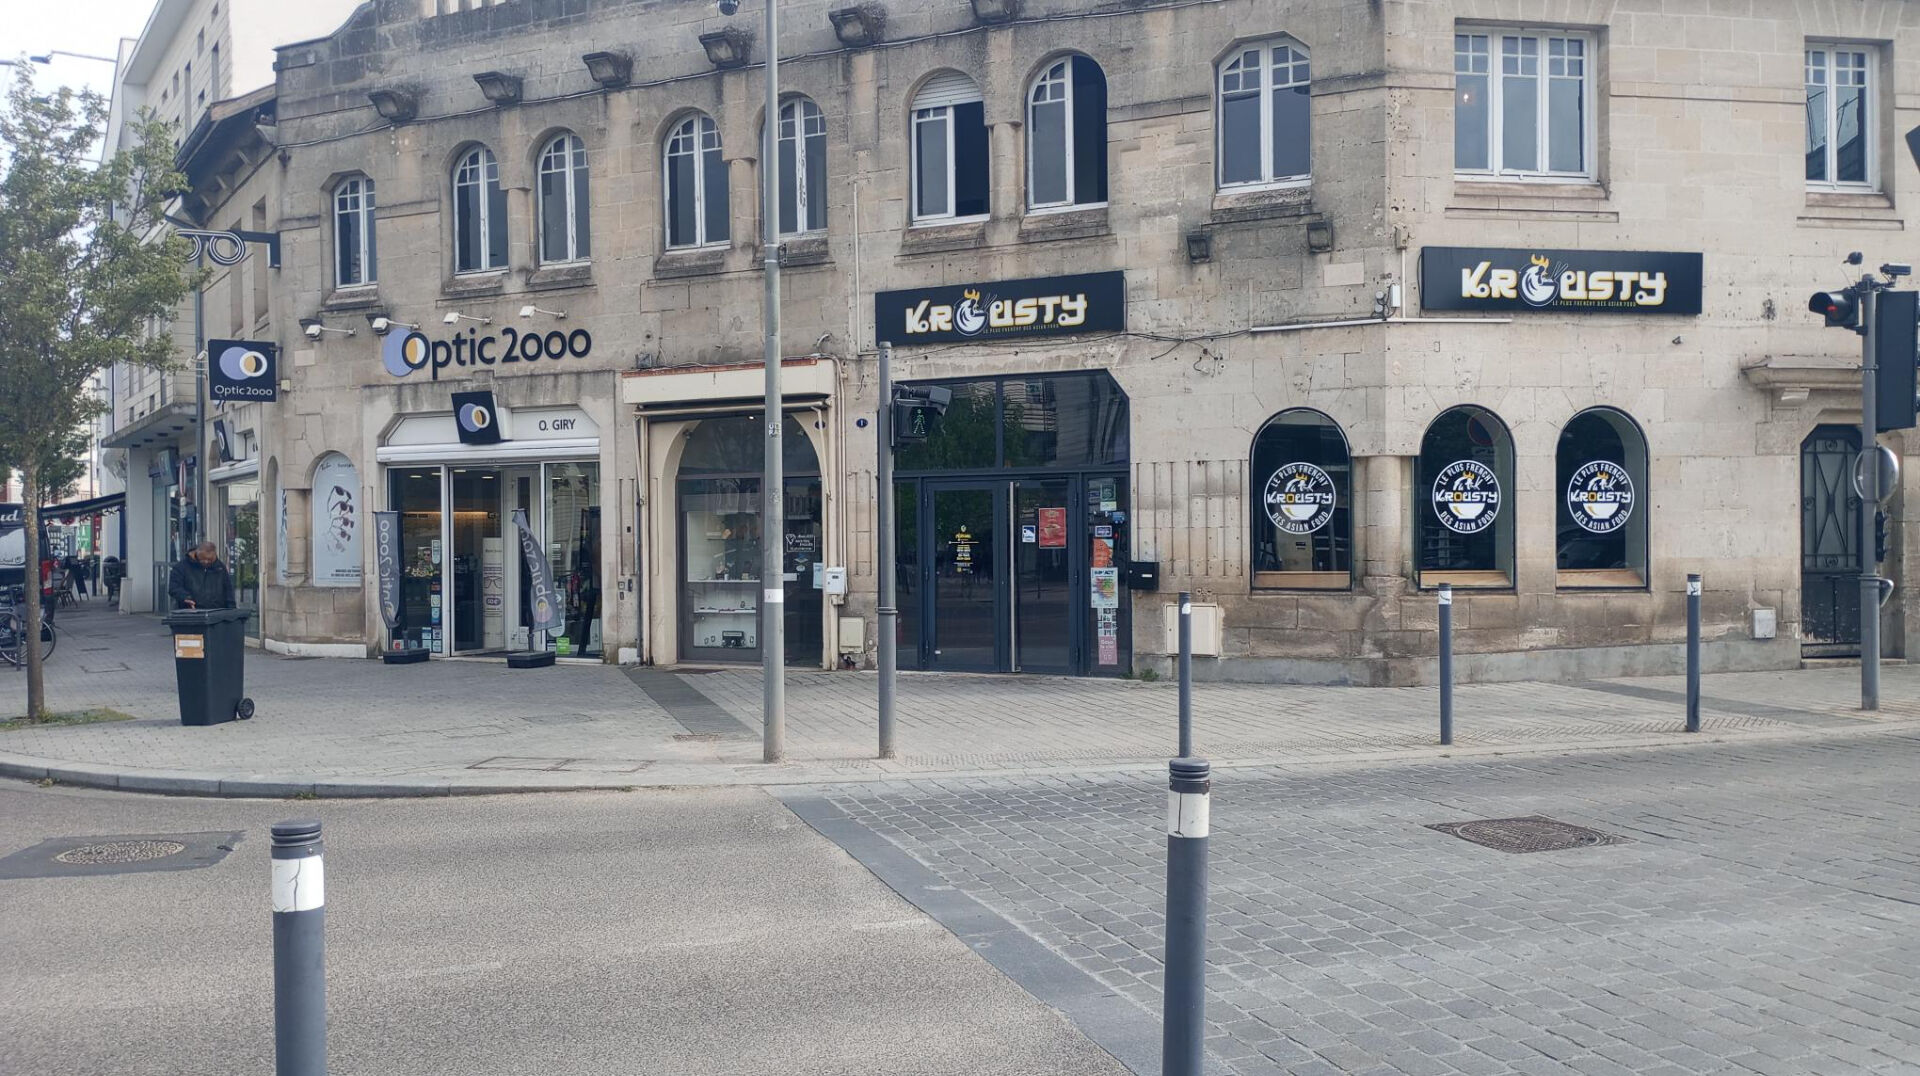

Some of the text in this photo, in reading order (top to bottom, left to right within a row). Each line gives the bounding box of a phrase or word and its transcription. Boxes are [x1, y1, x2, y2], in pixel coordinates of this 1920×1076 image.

[402, 327, 592, 380] Optic 2000
[214, 384, 273, 397] Optic 2000
[538, 419, 576, 431] O. GIRY
[1271, 465, 1329, 488] LE PLUS FRENCHY
[1439, 462, 1495, 486] LE PLUS FRENCHY
[1574, 463, 1628, 486] LE PLUS FRENCHY
[1267, 491, 1332, 504] KROUSTY
[1435, 489, 1498, 503] KROUSTY
[1570, 489, 1632, 503] KROUSTY
[1272, 511, 1329, 532] DES ASIAN FOOD
[1440, 510, 1495, 530] DES ASIAN FOOD
[1575, 510, 1628, 530] DES ASIAN FOOD
